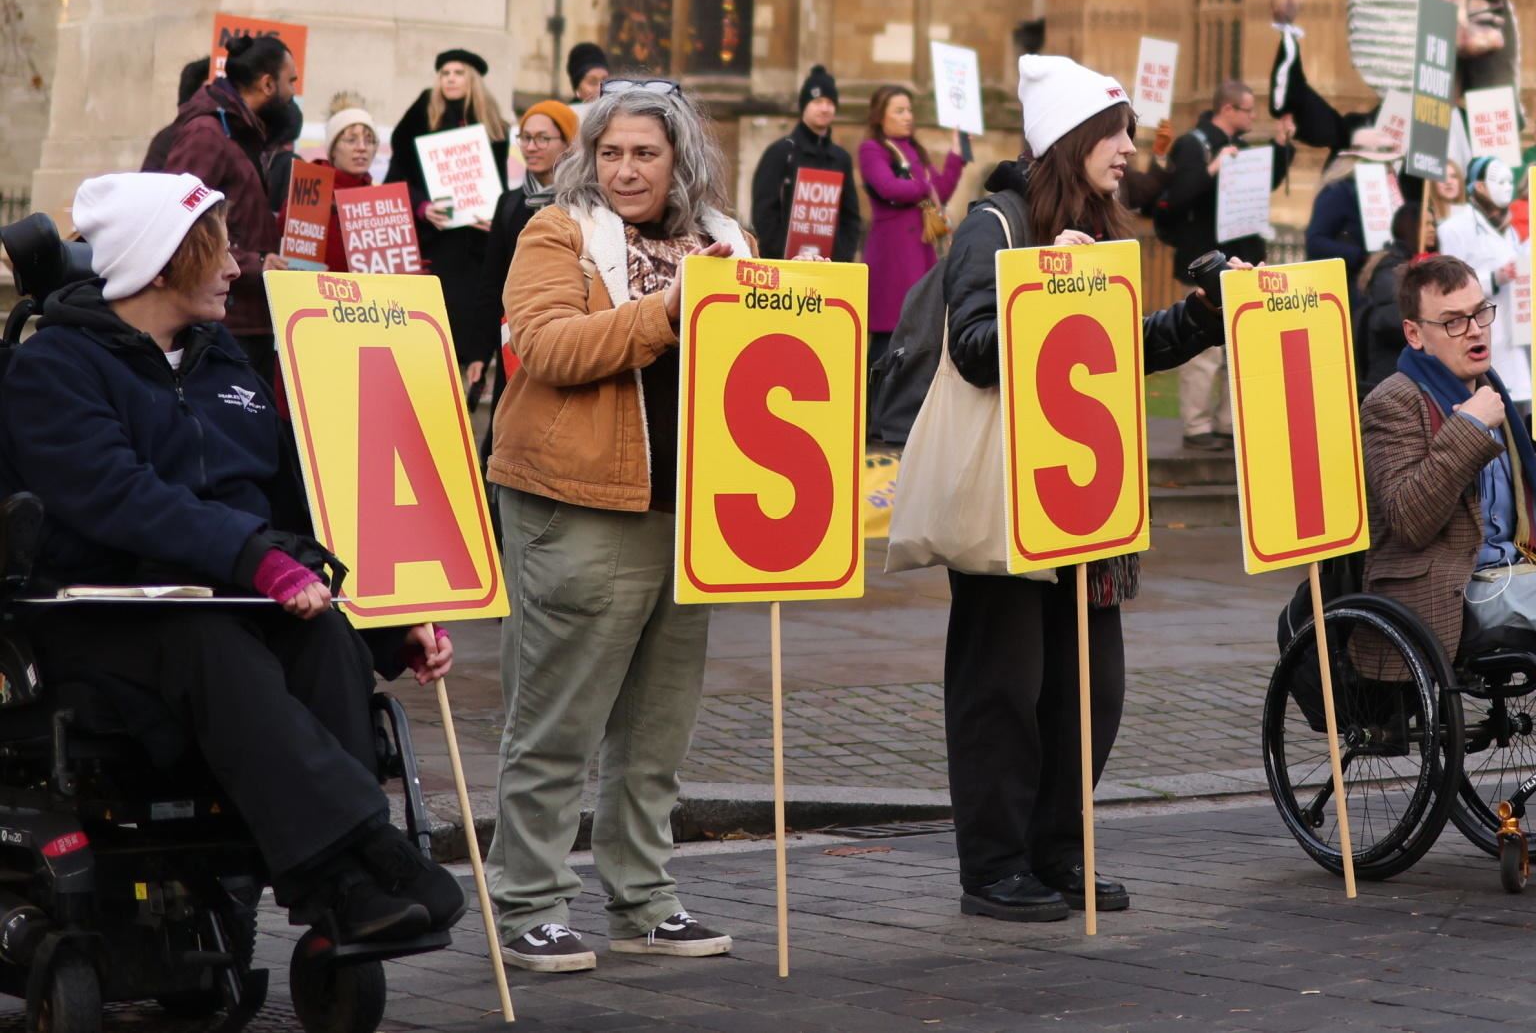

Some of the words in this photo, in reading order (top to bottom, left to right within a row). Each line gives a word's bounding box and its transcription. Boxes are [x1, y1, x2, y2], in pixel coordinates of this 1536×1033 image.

[1418, 63, 1450, 98] DOUBT
[1475, 113, 1492, 123] KILL
[1495, 110, 1509, 120] THE
[1496, 122, 1512, 132] NOT
[429, 149, 439, 161] IT
[442, 141, 480, 157] WON'T
[1479, 137, 1494, 147] THE
[437, 162, 450, 173] BE
[456, 155, 480, 168] OUR
[440, 168, 484, 186] CHOICE
[293, 177, 321, 206] NHS
[454, 183, 477, 196] FOR
[797, 182, 840, 204] NOW
[342, 202, 372, 219] THE
[375, 198, 408, 215] BILL
[793, 204, 806, 220] IS
[809, 206, 837, 223] NOT
[300, 222, 325, 240] CRADLE
[345, 214, 410, 232] SAFEGUARDS
[792, 221, 809, 234] THE
[812, 223, 833, 236] TIME
[286, 237, 296, 252] TO
[296, 239, 317, 256] GRAVE
[348, 225, 412, 251] ARENT
[350, 246, 421, 274] SAFE
[1044, 254, 1068, 272] not
[741, 266, 774, 288] not
[1047, 272, 1084, 295] dead
[1087, 273, 1107, 296] yet
[1262, 274, 1285, 291] not
[323, 278, 357, 301] not
[745, 287, 793, 310] dead
[797, 290, 822, 315] yet
[1267, 289, 1300, 312] dead
[1301, 290, 1319, 313] yet
[332, 300, 380, 323] dead
[381, 303, 407, 328] yet
[1033, 313, 1124, 536] S
[1280, 328, 1325, 540] I
[714, 333, 834, 572] S
[357, 347, 483, 597] A
